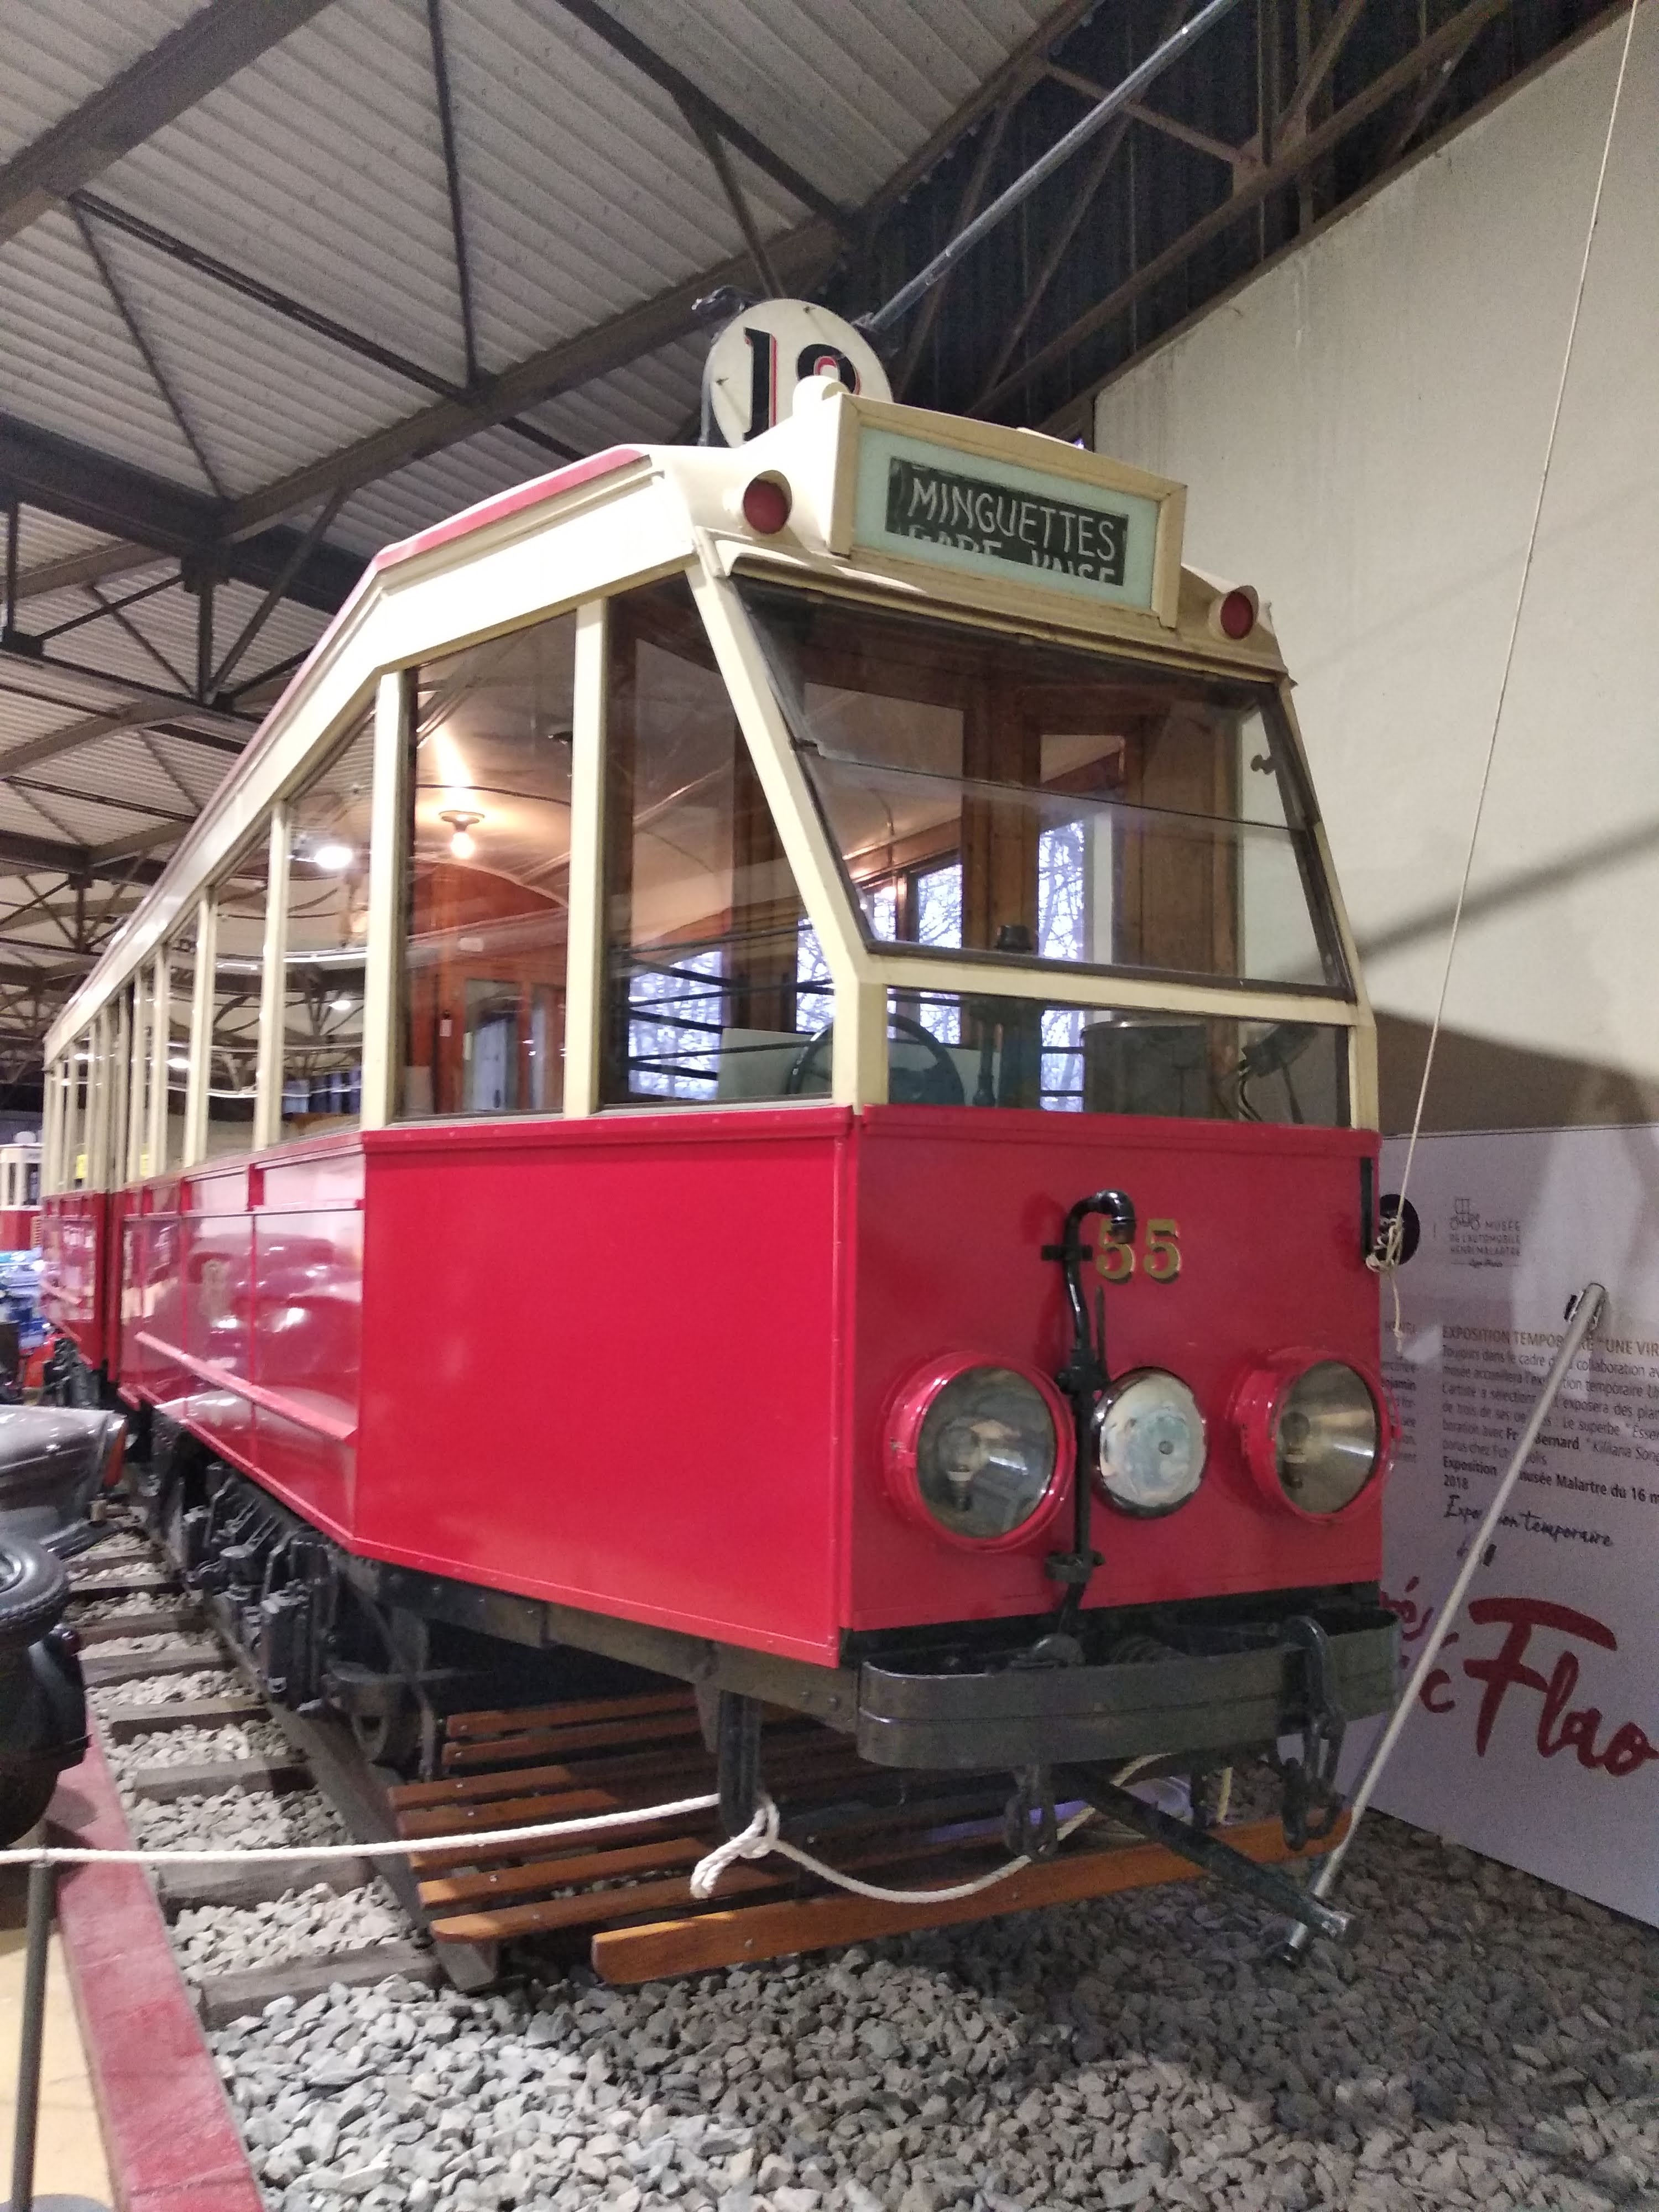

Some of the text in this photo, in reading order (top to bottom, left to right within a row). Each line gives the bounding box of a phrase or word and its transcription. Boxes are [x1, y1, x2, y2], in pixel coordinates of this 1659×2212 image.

[907, 478, 1115, 561] MINGUETTES
[1096, 1219, 1181, 1283] 55
[1520, 1353, 1545, 1366] cadre
[1614, 1403, 1632, 1416] des
[1579, 1421, 1620, 1436] superbe
[1443, 1455, 1496, 1476] Exposition
[1556, 1473, 1607, 1495] Malartre
[1611, 1484, 1627, 1499] du
[1632, 1488, 1646, 1502] 16
[1444, 1474, 1468, 1489] 2018
[1463, 1598, 1659, 1777] Flao
